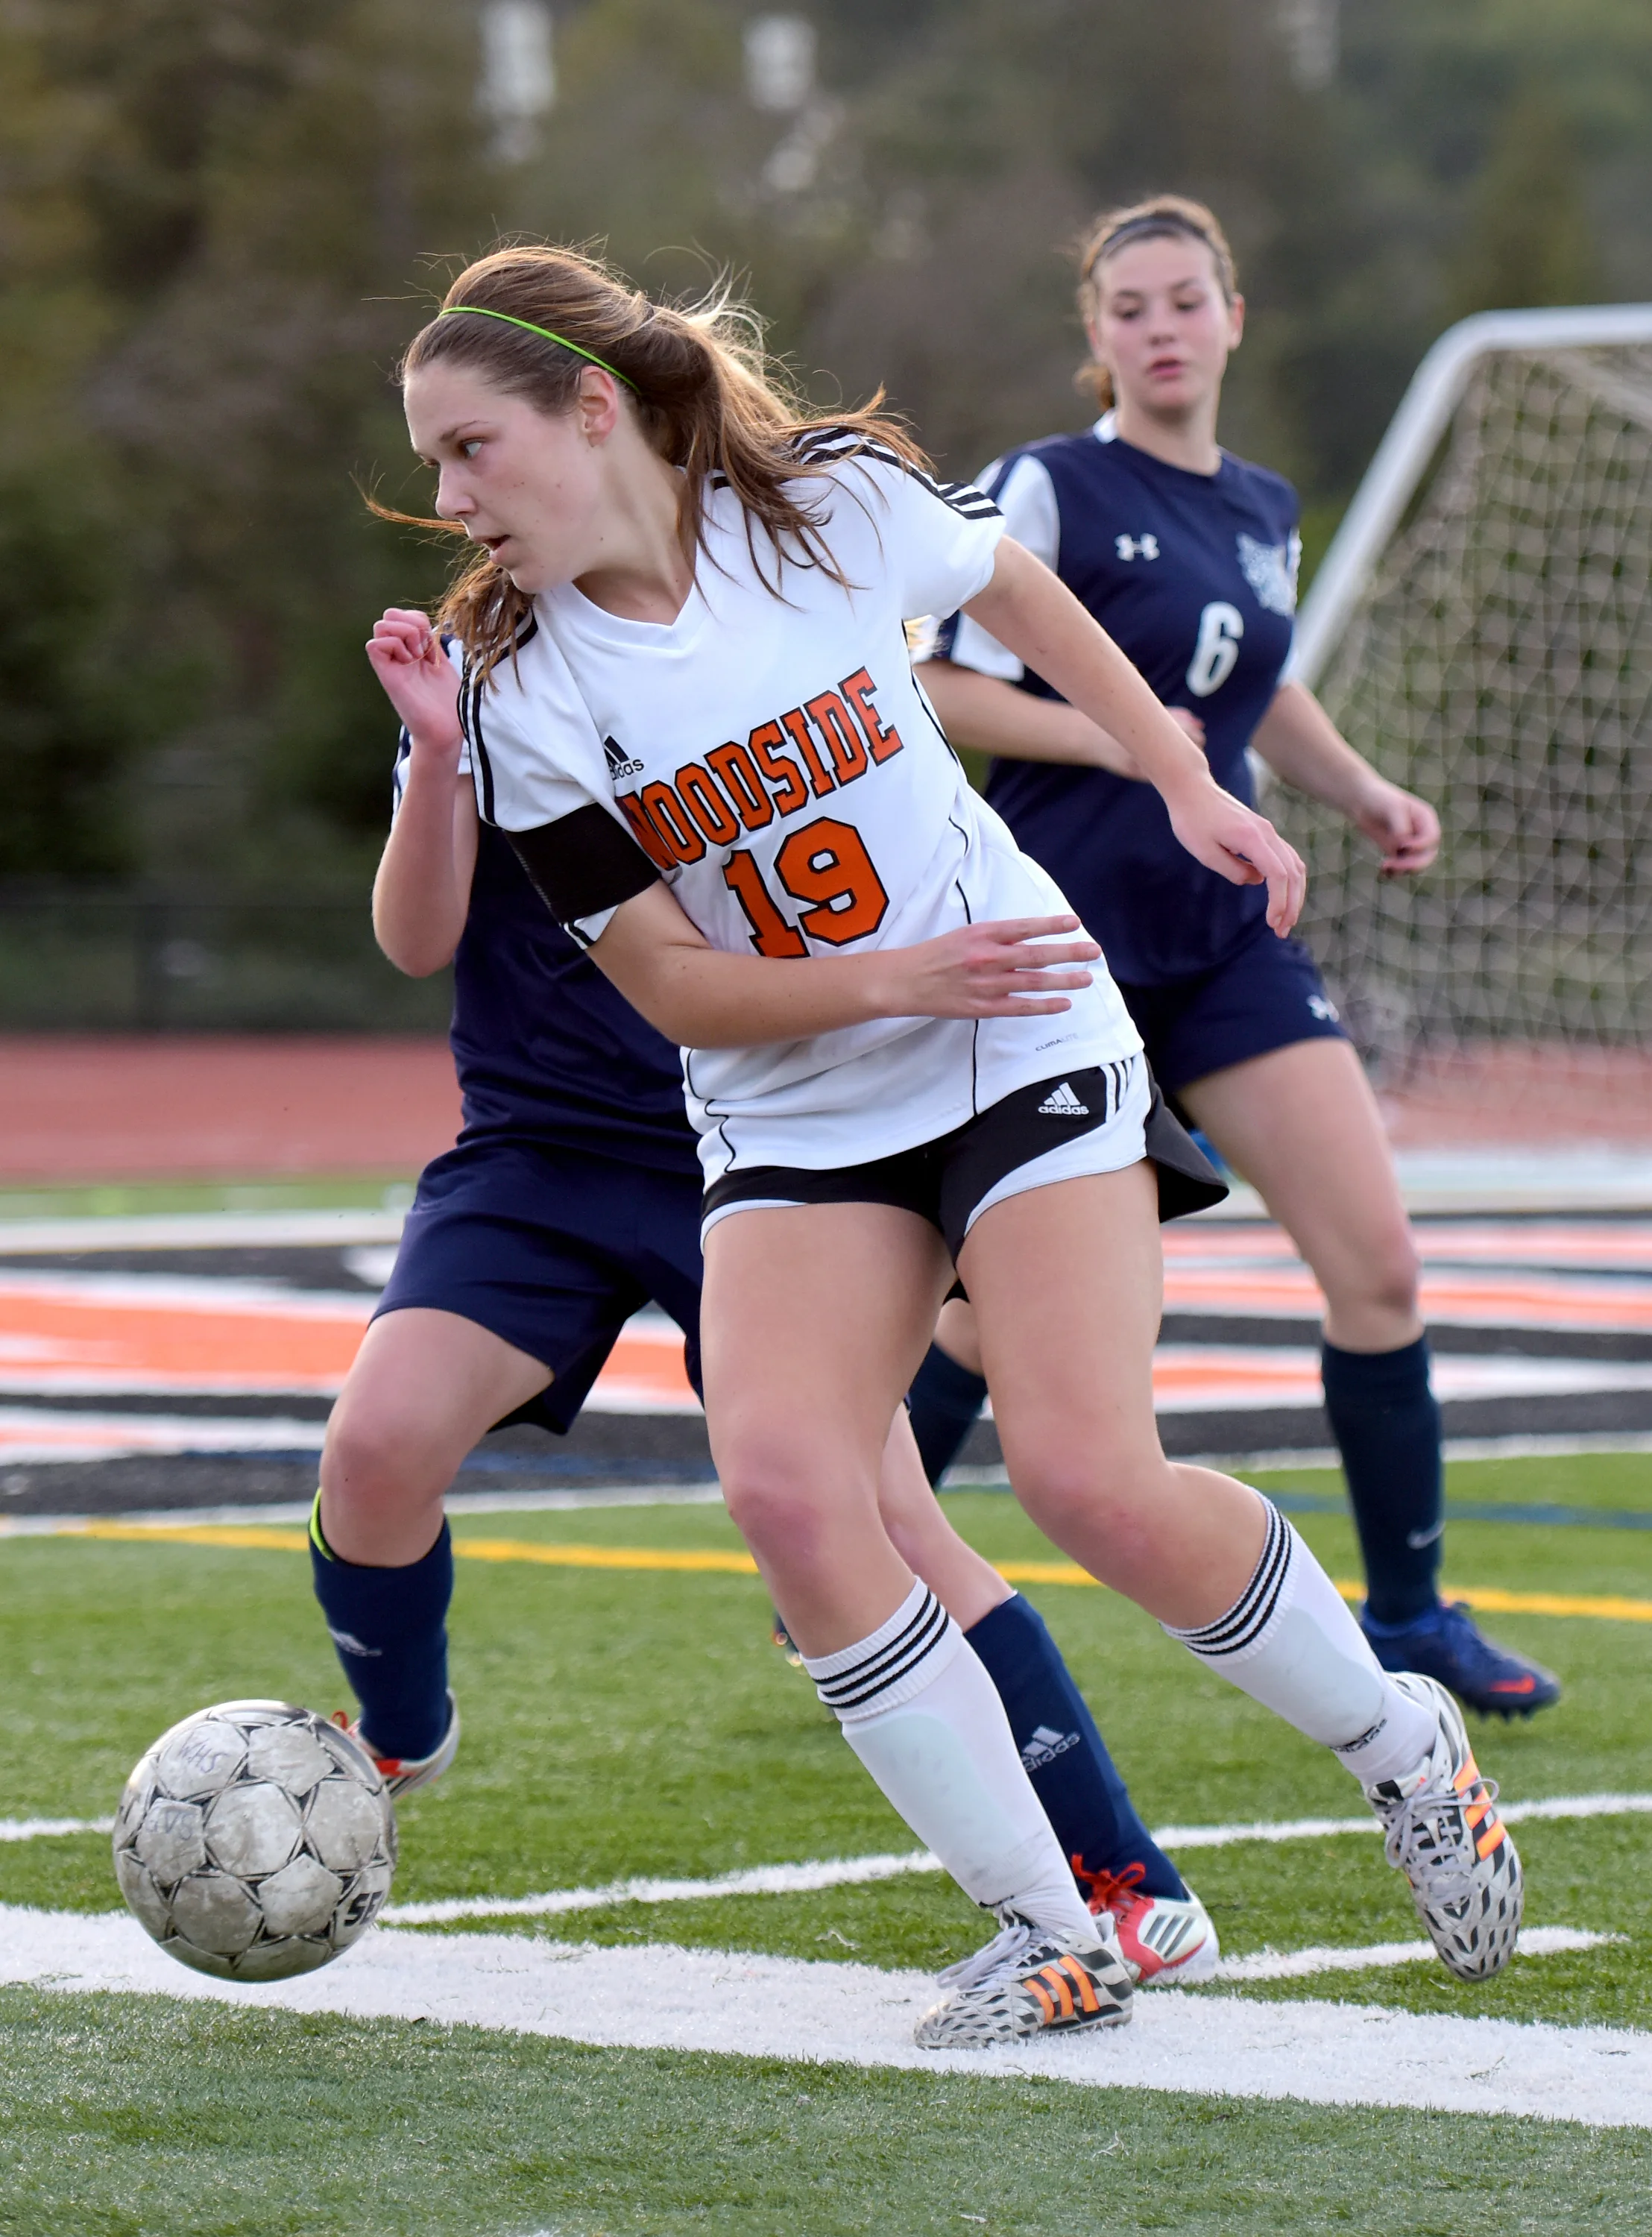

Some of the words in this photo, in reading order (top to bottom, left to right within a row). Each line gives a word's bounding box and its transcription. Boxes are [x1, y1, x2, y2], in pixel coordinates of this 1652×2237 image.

[1185, 601, 1244, 698] 6
[610, 758, 645, 781] didas
[722, 817, 889, 958] 19
[1038, 1105, 1089, 1116] adidas
[1022, 1731, 1080, 1772] didas
